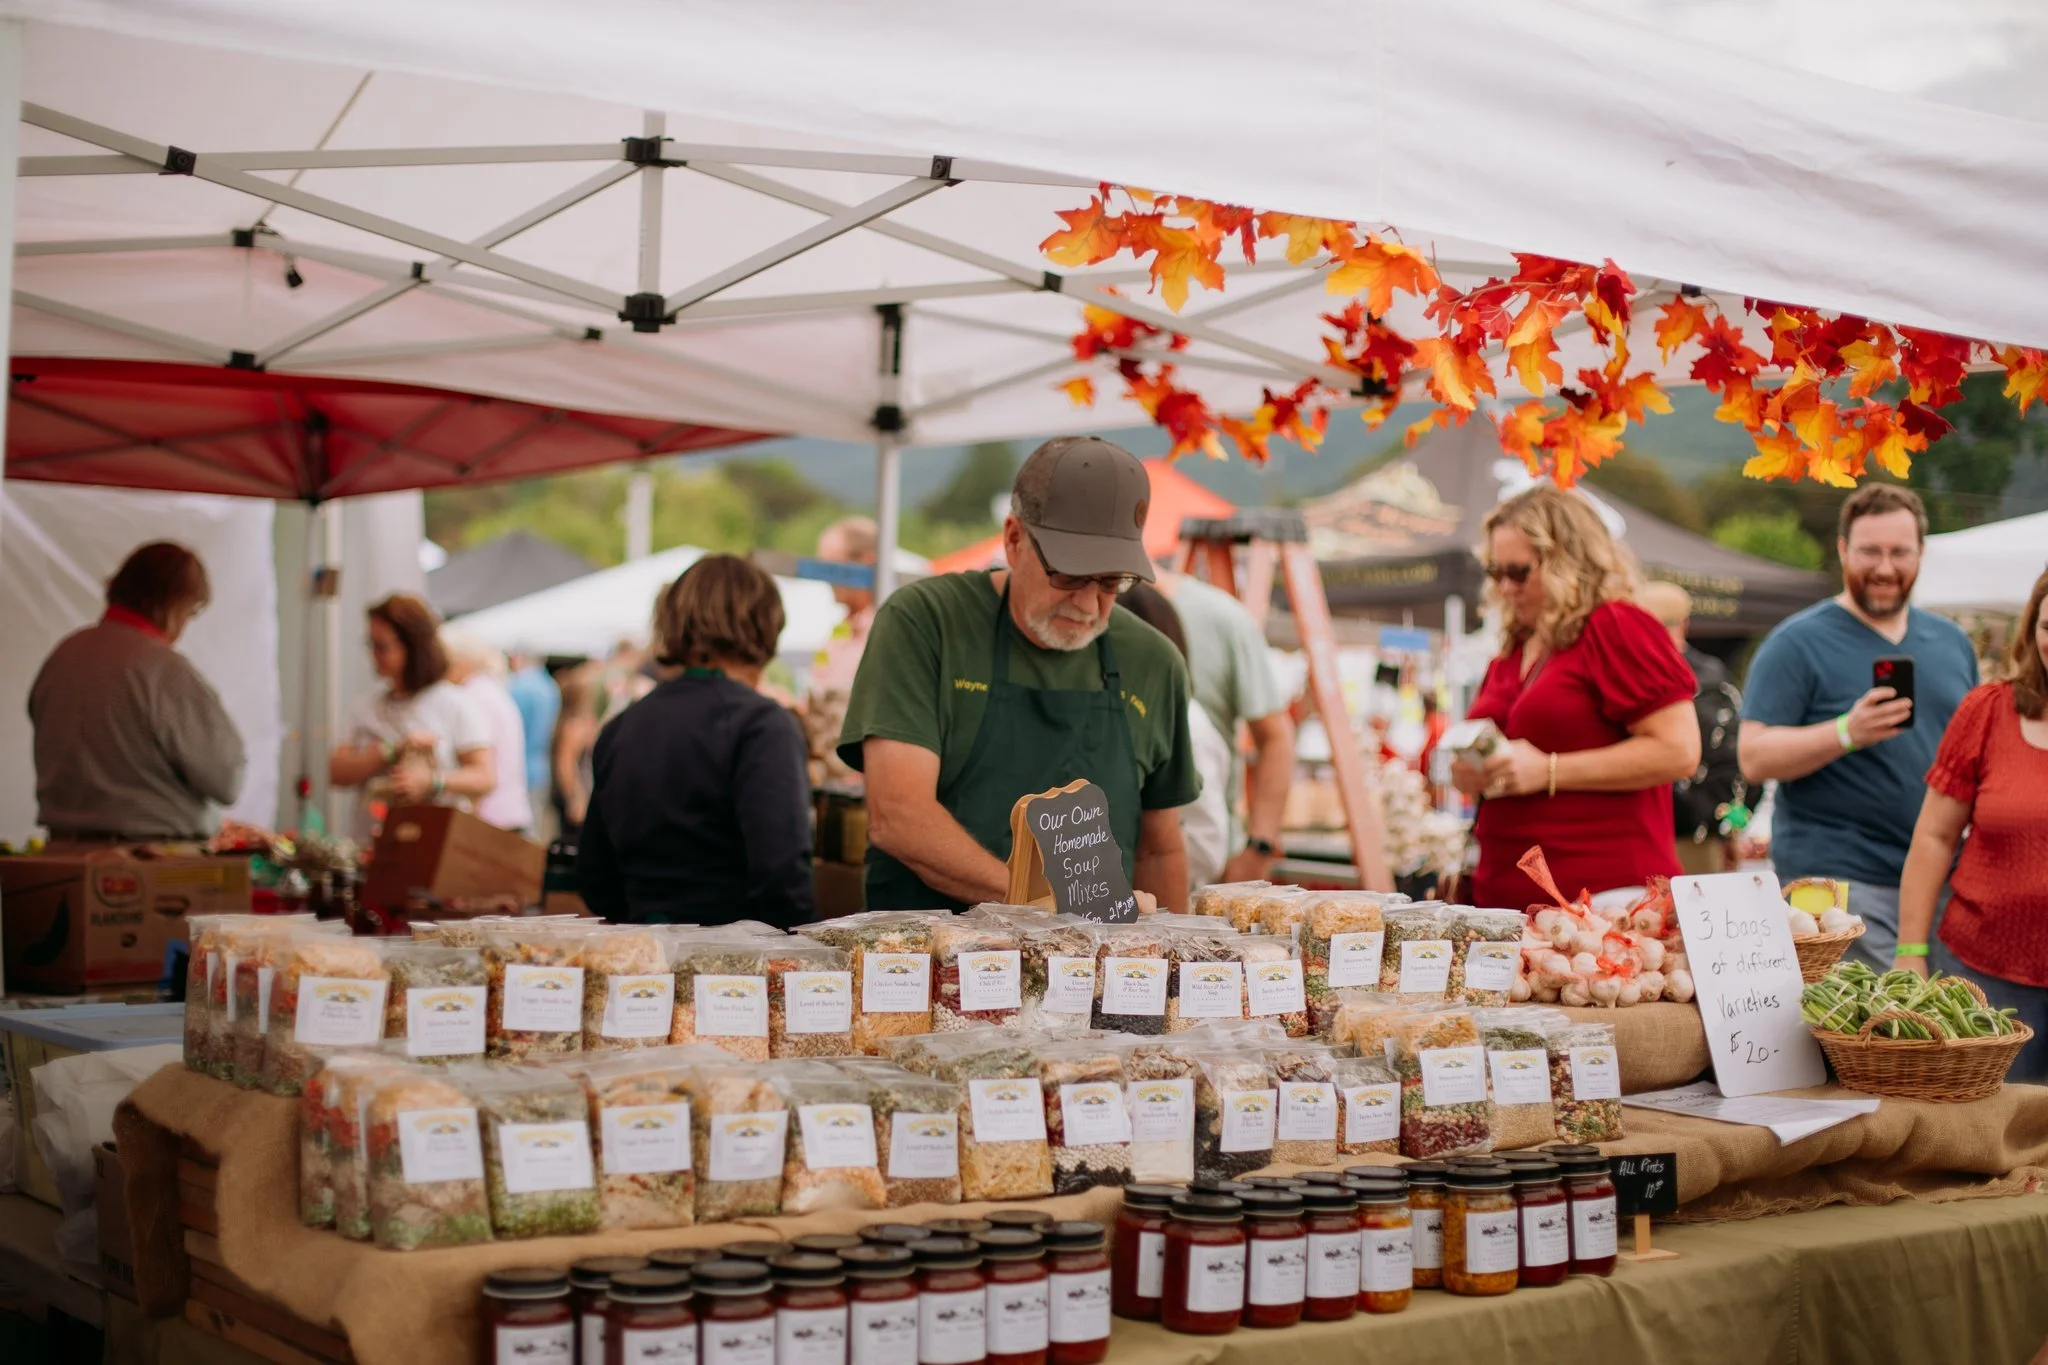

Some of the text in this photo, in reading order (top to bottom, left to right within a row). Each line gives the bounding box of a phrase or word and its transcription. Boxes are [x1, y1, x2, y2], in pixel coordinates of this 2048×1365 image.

[954, 679, 989, 692] Wayne
[1040, 806, 1104, 830] Our Own
[1053, 825, 1109, 855] Homemade
[1063, 855, 1100, 879] Soup
[1068, 879, 1110, 907] Mixes
[1696, 909, 1771, 947] 3 bags
[1711, 948, 1792, 975] of different
[1717, 987, 1780, 1019] Varieties
[1641, 1157, 1664, 1173] Pints
